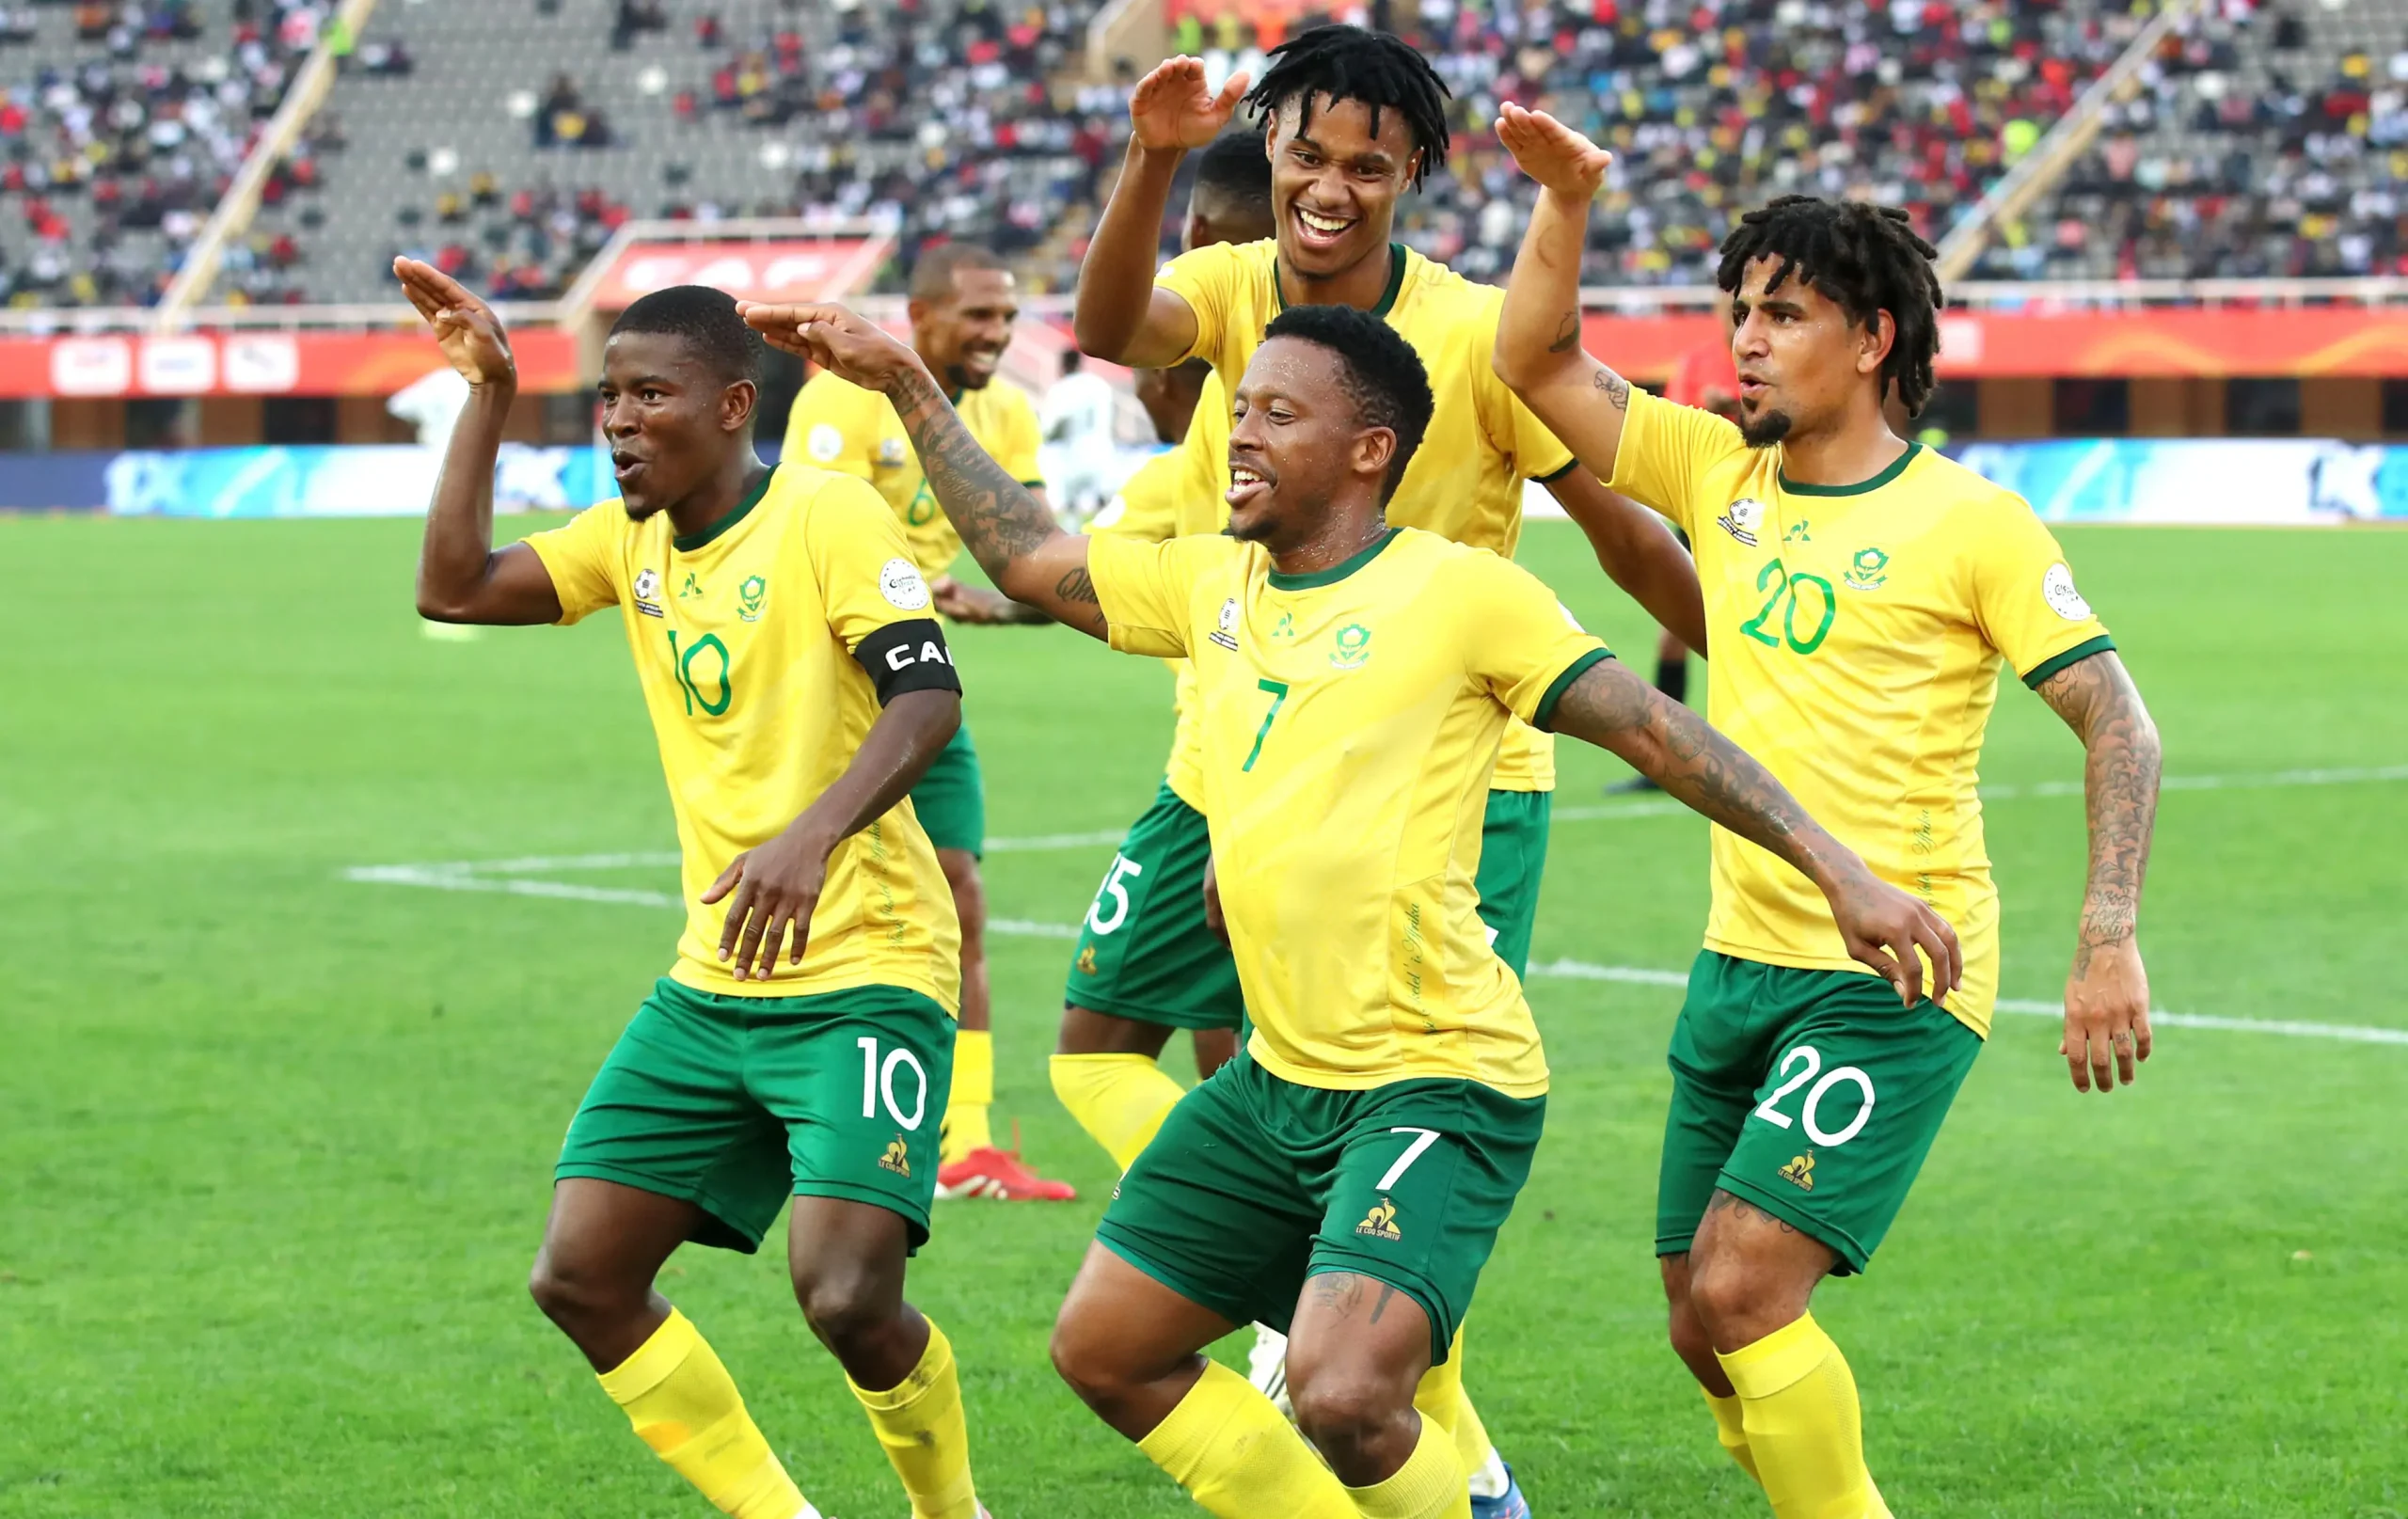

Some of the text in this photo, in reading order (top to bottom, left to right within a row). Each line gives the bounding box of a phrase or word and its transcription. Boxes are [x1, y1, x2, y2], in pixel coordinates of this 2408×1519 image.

[909, 477, 934, 527] 6
[1739, 558, 1835, 655] 20
[667, 630, 731, 716] 10
[885, 641, 954, 671] CA
[1242, 678, 1289, 772] 7
[857, 1036, 927, 1131] 10
[1754, 1045, 1876, 1147] 20
[1375, 1127, 1441, 1191] 7
